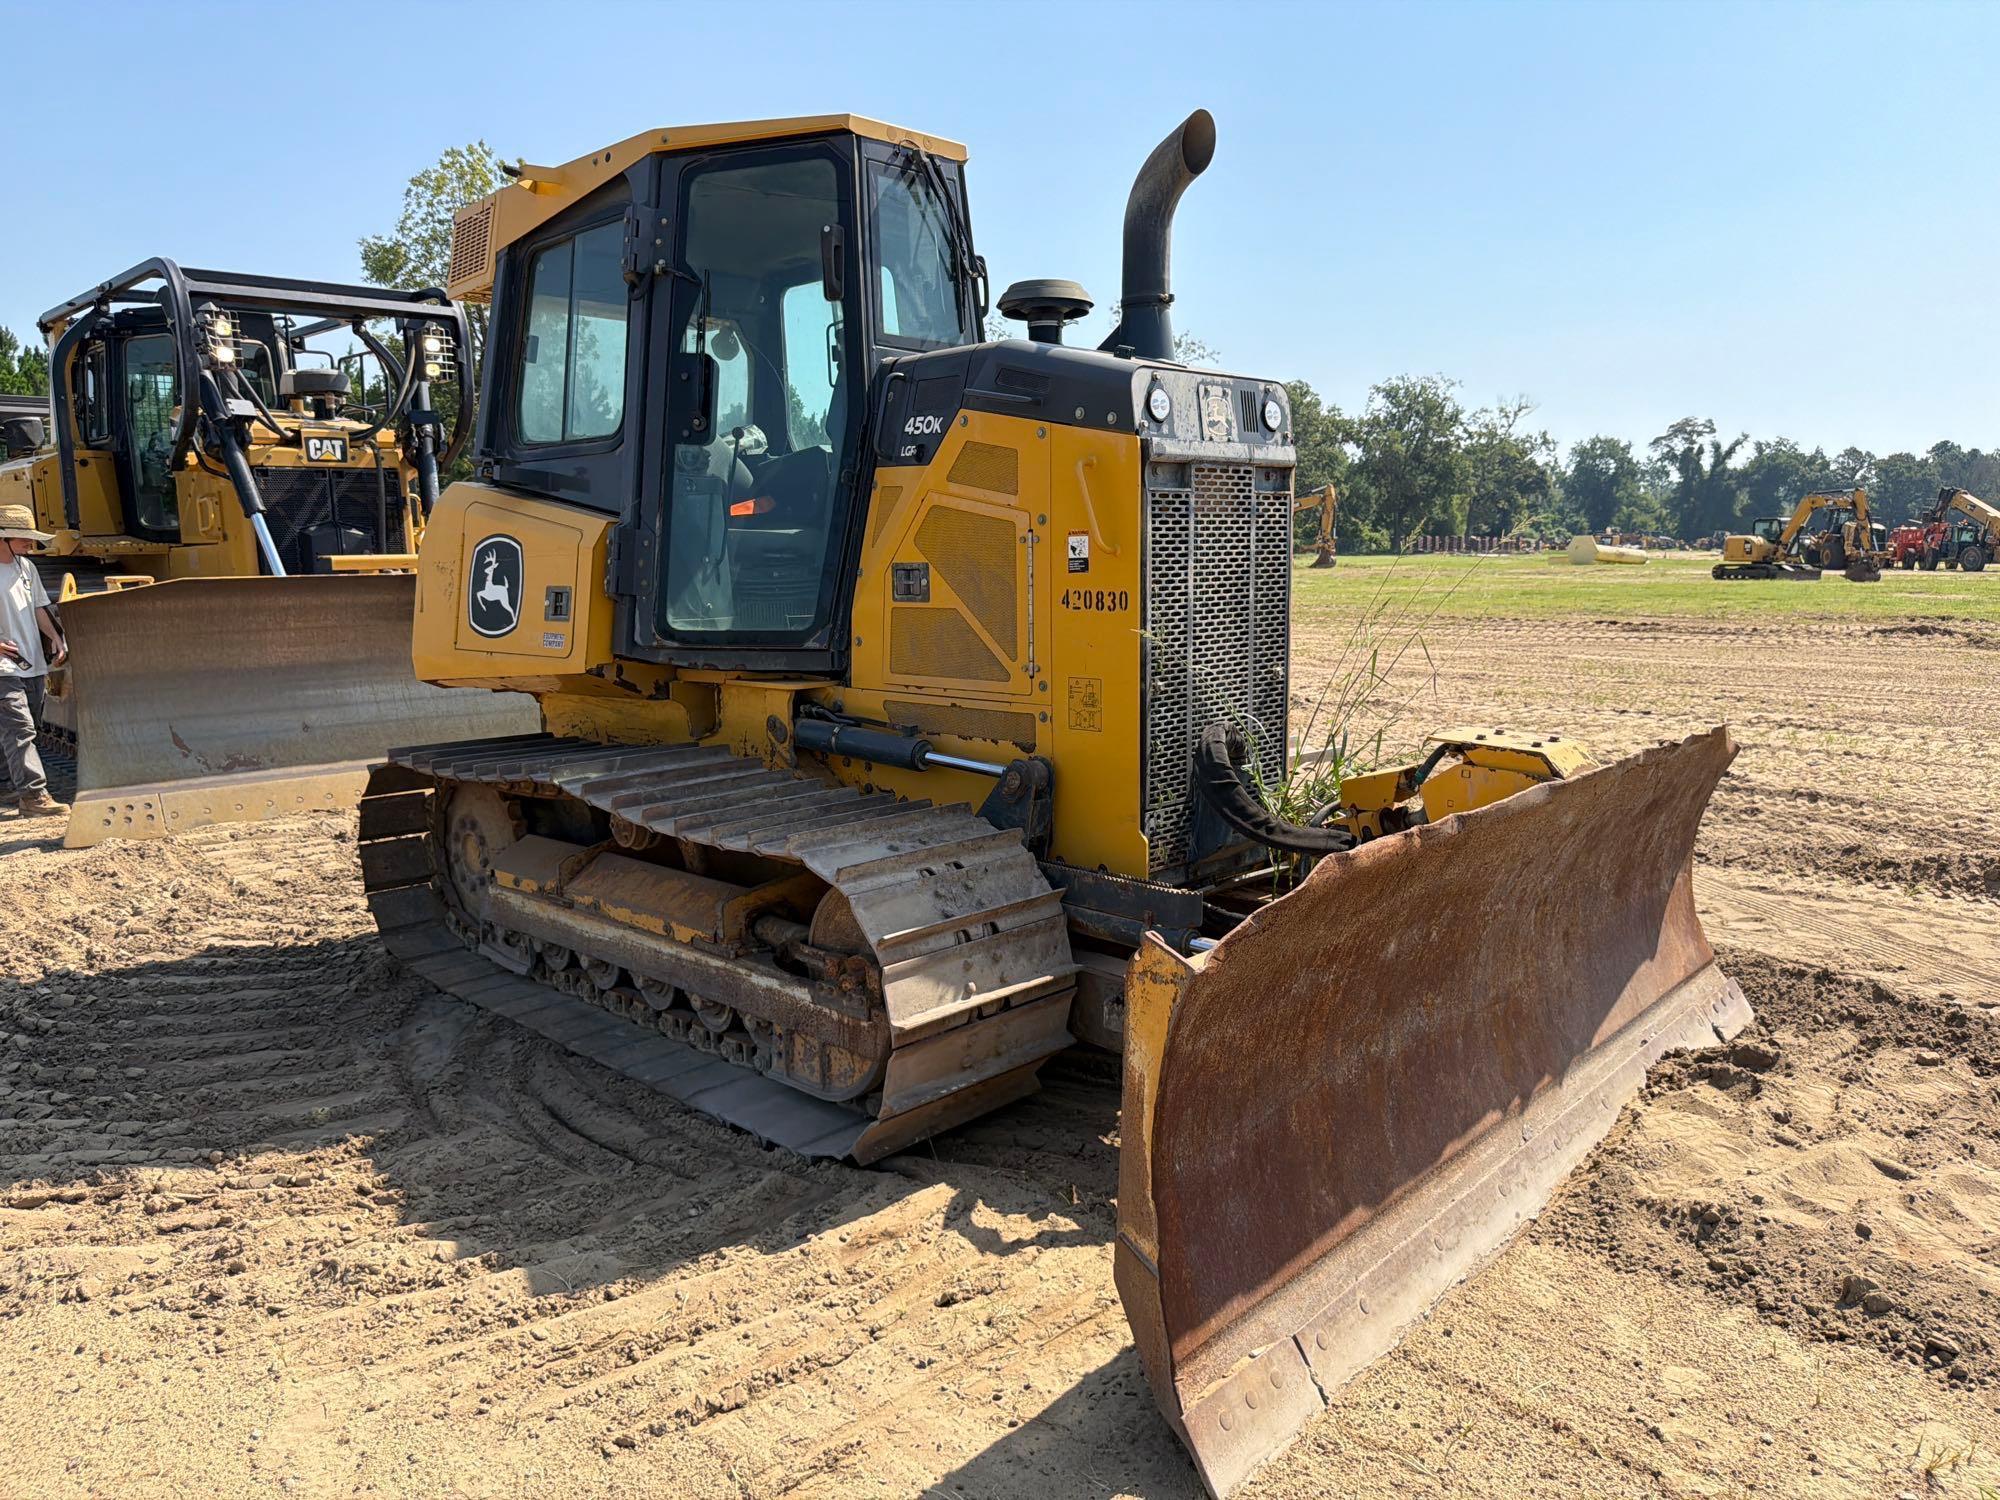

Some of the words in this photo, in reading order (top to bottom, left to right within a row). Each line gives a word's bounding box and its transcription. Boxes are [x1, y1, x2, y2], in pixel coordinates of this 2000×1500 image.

[904, 415, 944, 435] 450K
[308, 438, 343, 460] CAT
[1061, 588, 1129, 612] 420830
